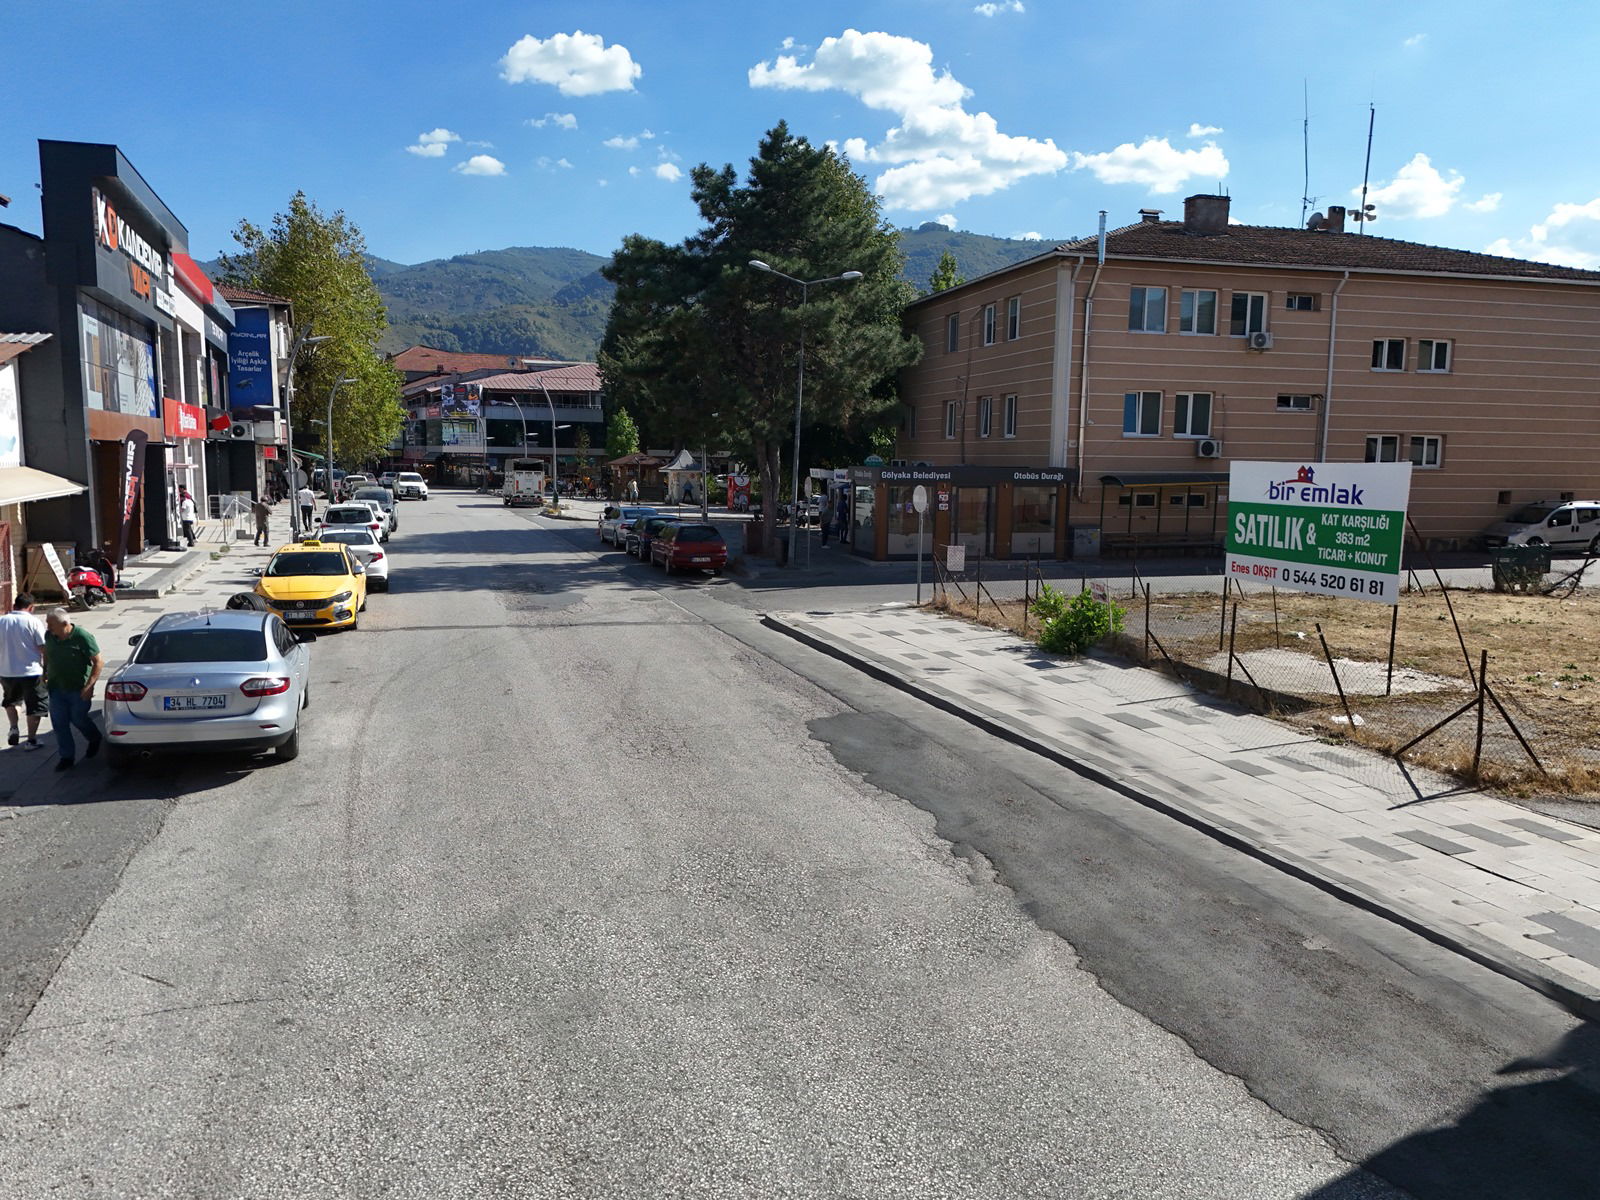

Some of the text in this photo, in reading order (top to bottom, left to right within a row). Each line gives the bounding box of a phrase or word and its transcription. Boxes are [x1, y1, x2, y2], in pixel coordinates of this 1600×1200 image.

[237, 350, 260, 358] Arçelik
[236, 364, 263, 373] Tasarlar
[881, 470, 911, 481] Gölyaka
[913, 470, 951, 482] Belediyesi
[1013, 472, 1039, 481] Otobüs
[1040, 472, 1065, 481] Durağı
[1269, 480, 1364, 506] bir emlak
[1321, 513, 1390, 532] KAT KARŞILIĞI
[1234, 512, 1317, 551] SATILIK &
[1335, 532, 1371, 546] 363 m2
[1354, 551, 1388, 566] KONUT
[1231, 561, 1384, 596] Enes OKŞİT 0 544 520 61 81
[169, 697, 223, 707] 34 HL 7704
